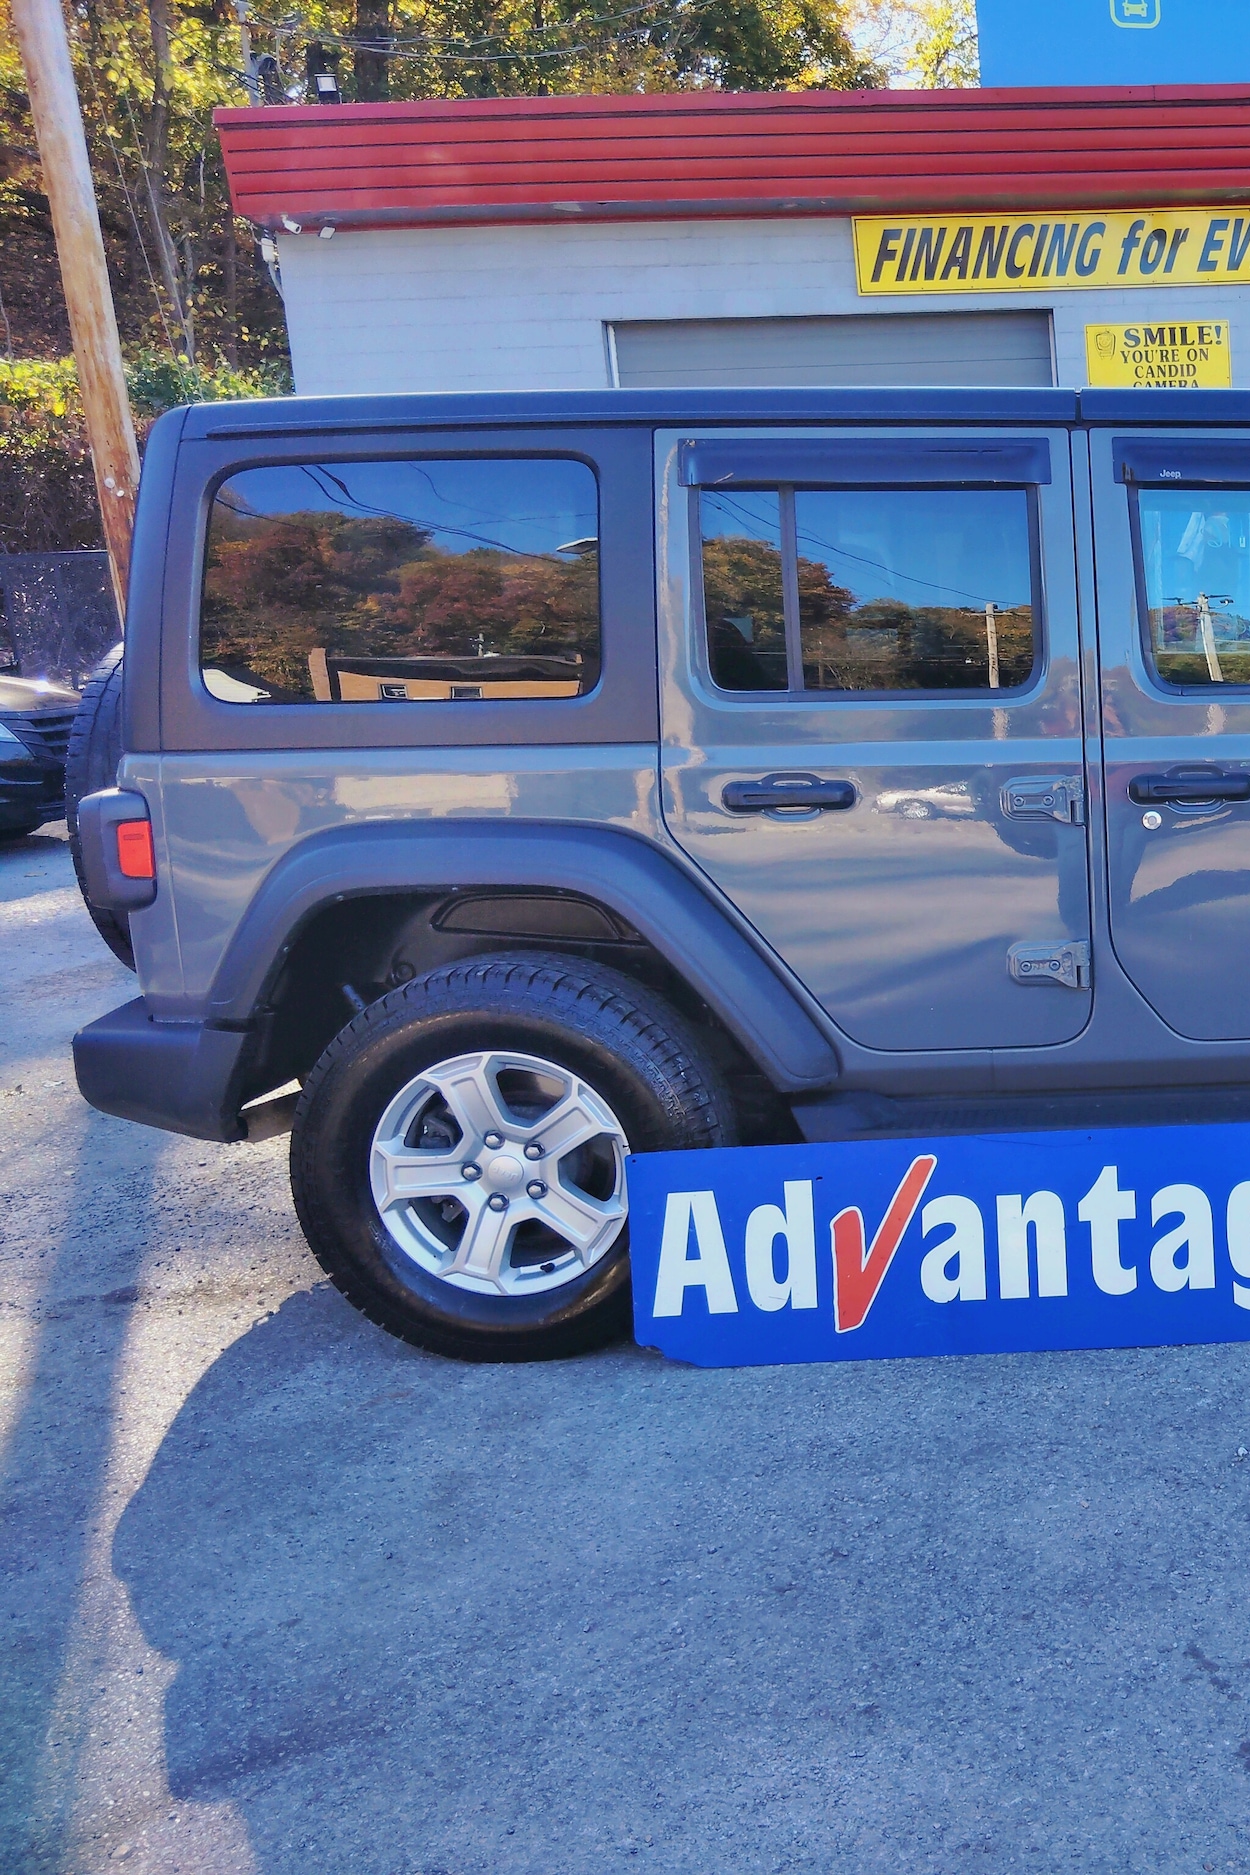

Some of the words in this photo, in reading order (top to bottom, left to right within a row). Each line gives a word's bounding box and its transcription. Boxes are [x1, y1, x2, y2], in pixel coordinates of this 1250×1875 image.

[870, 223, 1104, 283] FINANCING
[1117, 219, 1190, 277] for
[1123, 325, 1222, 348] SMILE!
[1120, 349, 1180, 364] YOU'RE
[1186, 347, 1209, 362] ON
[1134, 363, 1197, 379] CANDID
[1160, 469, 1181, 479] Jeep
